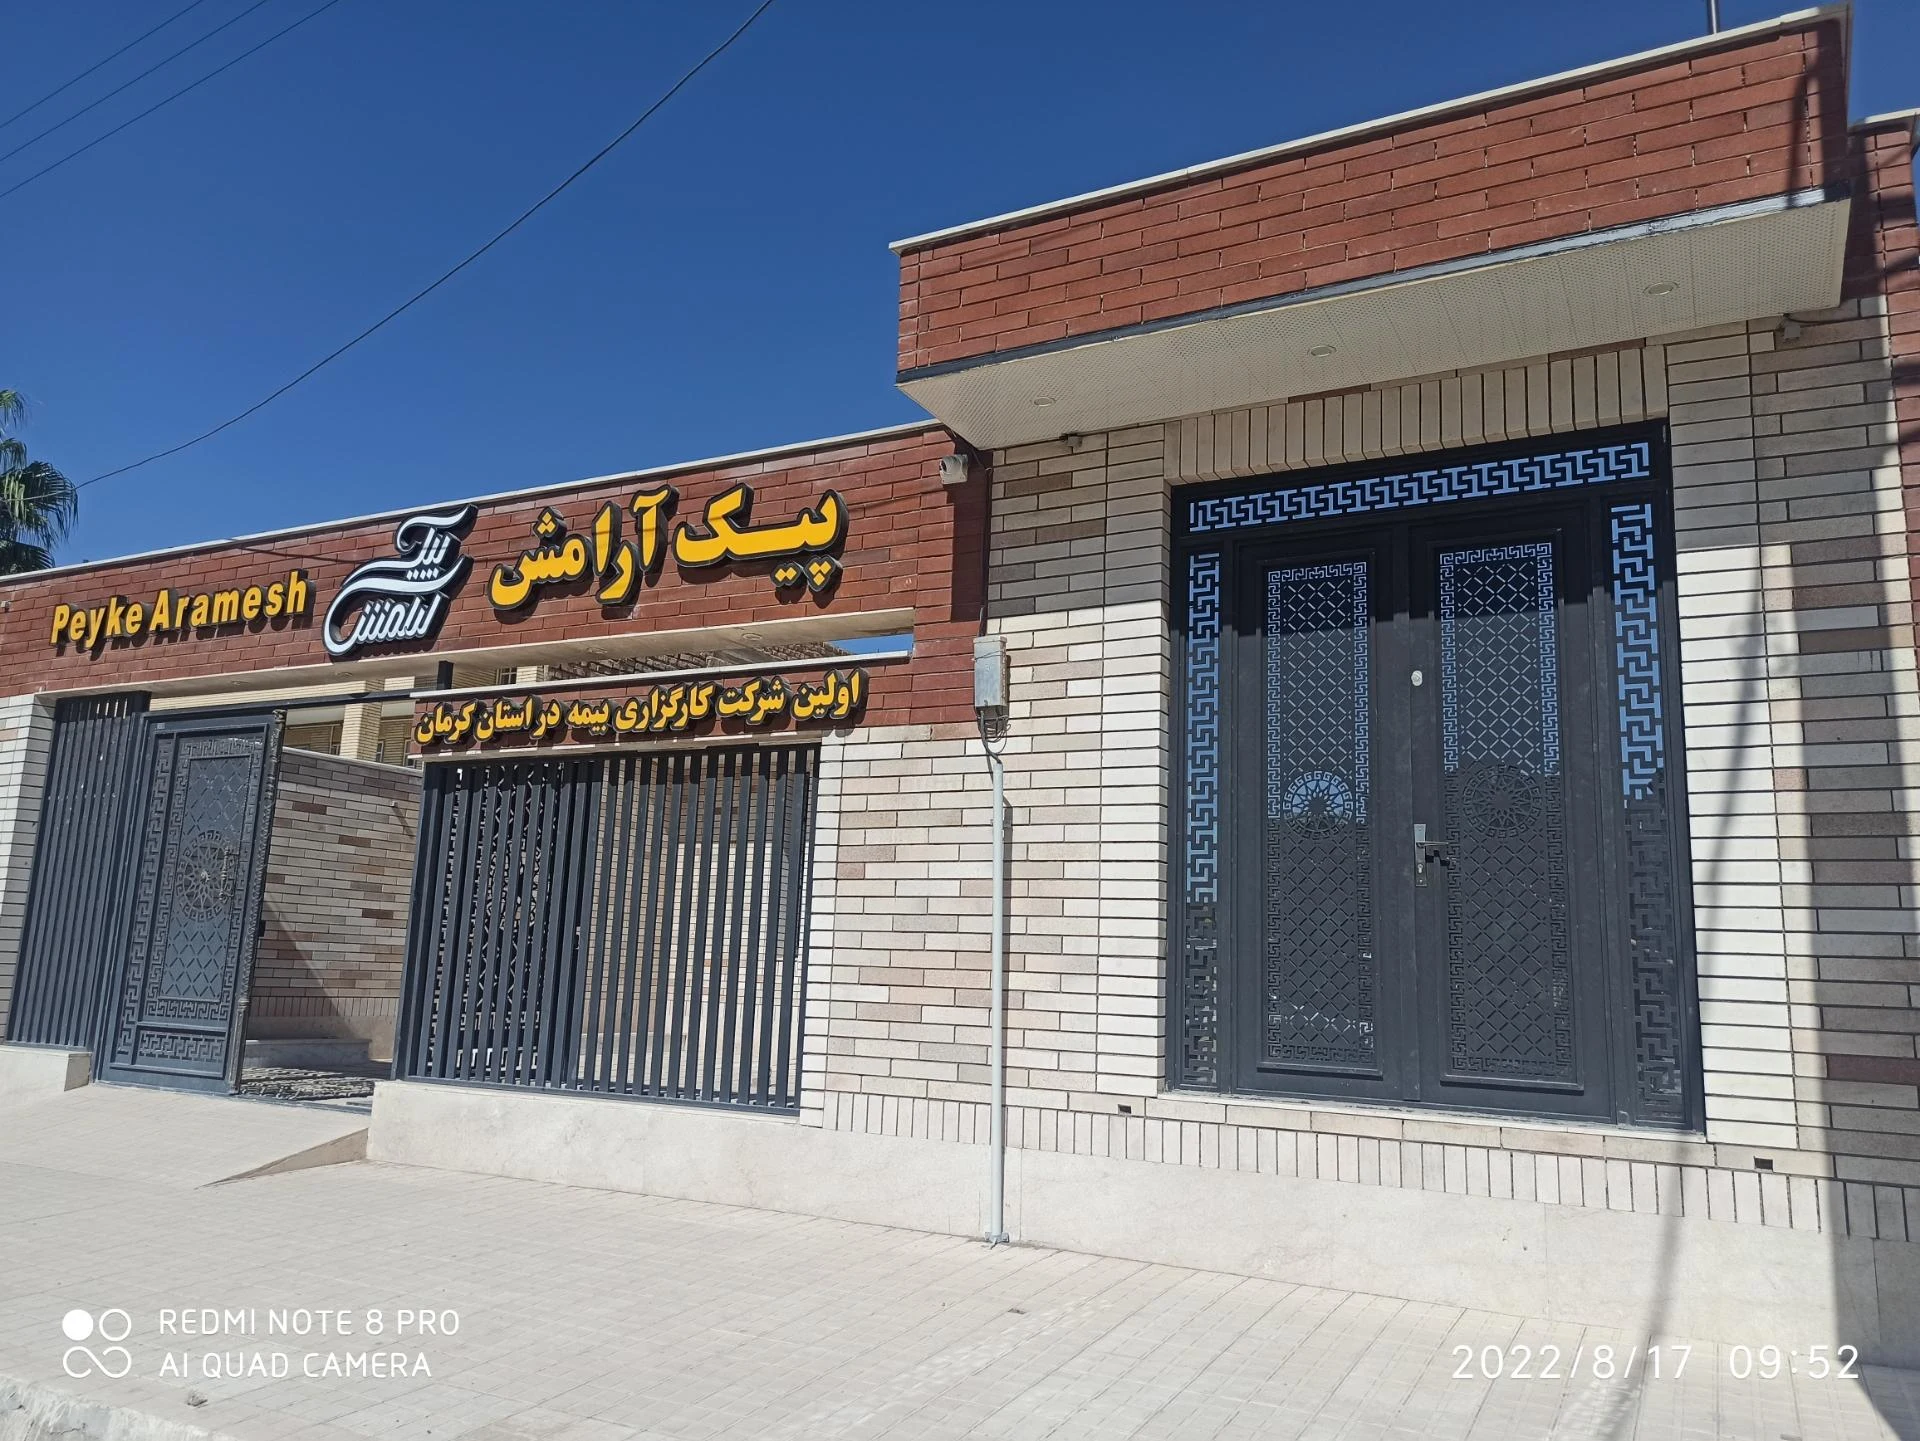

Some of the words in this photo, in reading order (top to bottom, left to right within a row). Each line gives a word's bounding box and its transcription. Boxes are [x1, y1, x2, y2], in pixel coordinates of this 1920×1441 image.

[490, 488, 669, 606] آرامش
[675, 487, 838, 585] پیک
[50, 595, 143, 649] Peyke
[150, 571, 307, 632] Aramesh
[476, 694, 533, 740] استان
[567, 700, 610, 733] بیمه
[615, 685, 714, 730] کارگزاری
[717, 679, 785, 722] شرکت
[792, 670, 860, 719] اولین
[416, 702, 475, 742] کرمان
[533, 698, 561, 737] در
